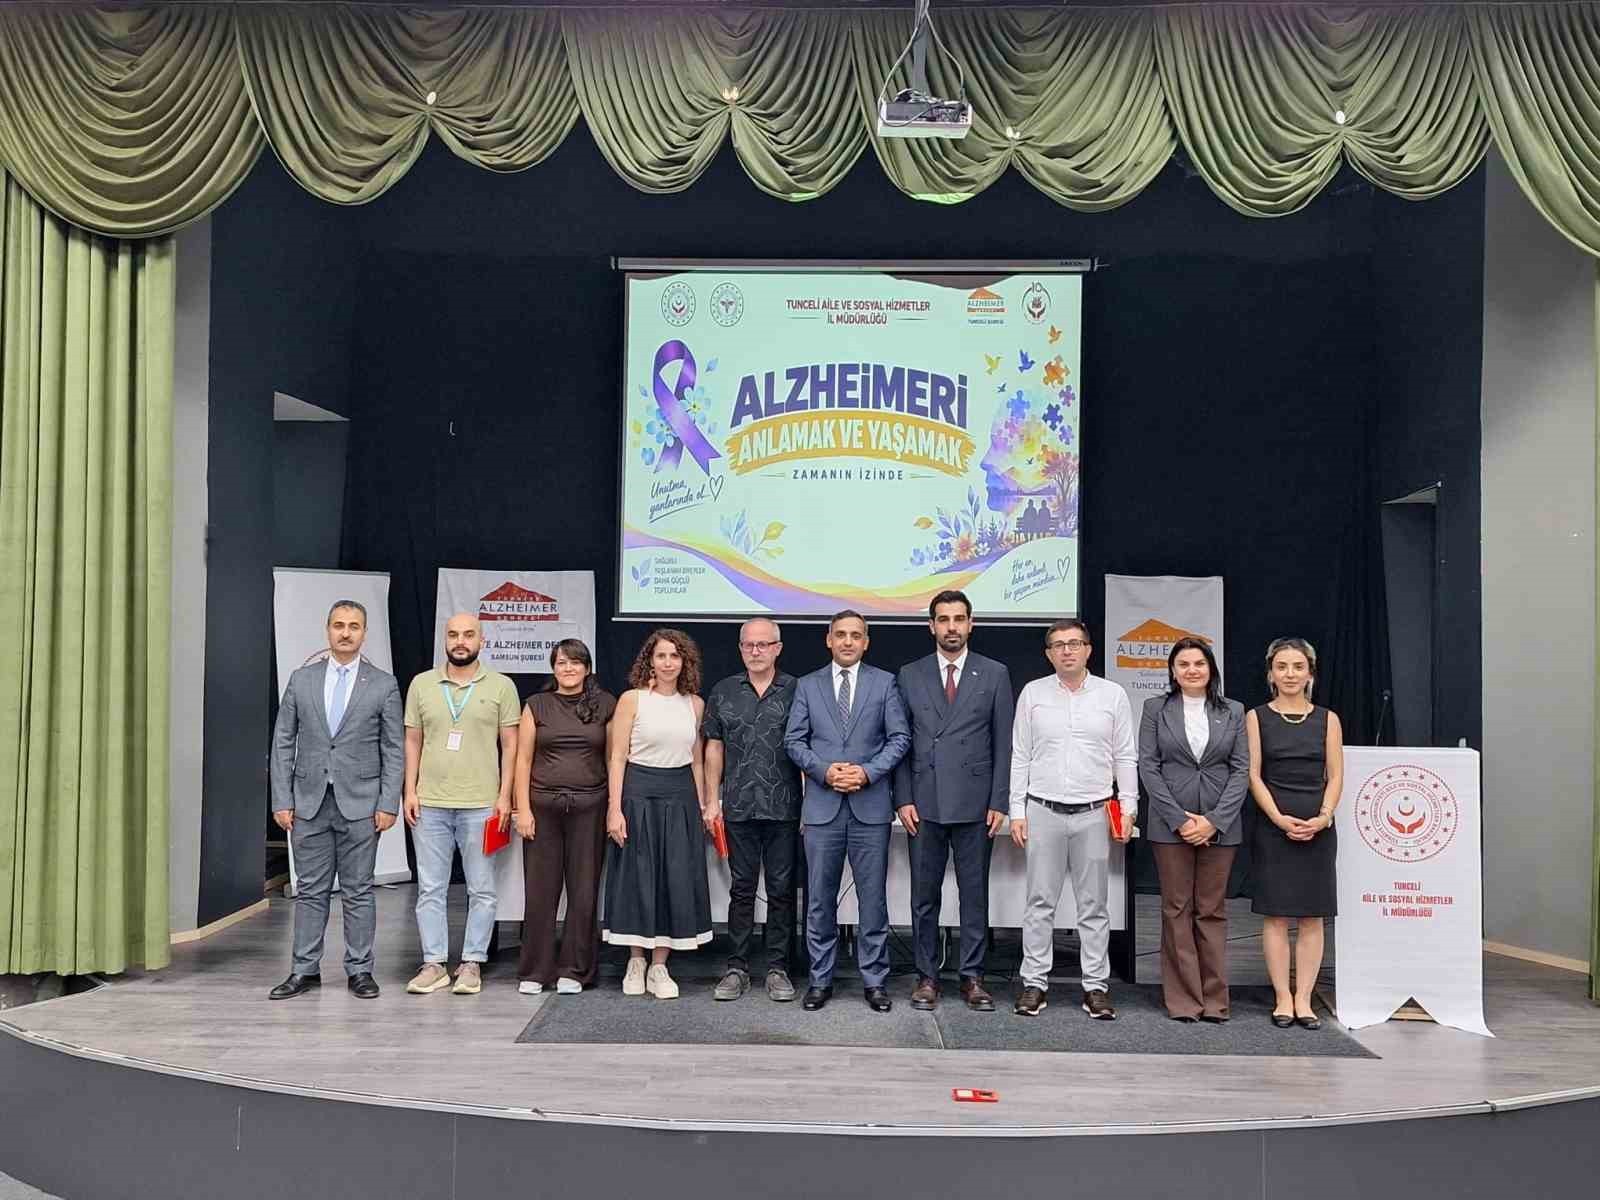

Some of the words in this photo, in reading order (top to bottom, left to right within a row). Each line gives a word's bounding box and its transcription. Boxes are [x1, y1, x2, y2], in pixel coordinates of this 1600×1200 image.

[786, 297, 820, 309] TUNCELİ
[822, 297, 839, 310] AİLE
[841, 300, 852, 310] VE
[853, 300, 884, 311] SOSYAL
[886, 298, 930, 311] HİZMETLER
[827, 312, 834, 324] İL
[836, 312, 887, 325] MÜDÜRLÜĞÜ
[738, 419, 838, 466] ANLAMAK
[839, 418, 864, 449] VE
[867, 419, 962, 468] YAŞAMAK
[792, 470, 852, 480] ZAMANIN
[859, 467, 903, 480] İZİNDE
[480, 602, 557, 613] ALZHEIMER
[493, 640, 542, 649] ALZHEIMER
[520, 653, 545, 662] ŞUBESİ
[1394, 881, 1421, 891] TUNCELİ
[1362, 892, 1377, 903] AİLE
[1378, 894, 1387, 903] VE
[1388, 894, 1414, 904] SOSYAL
[1415, 894, 1453, 905] HİZMETLER
[1382, 906, 1389, 917] İL
[1391, 906, 1433, 917] MÜDÜRLÜĞÜ
